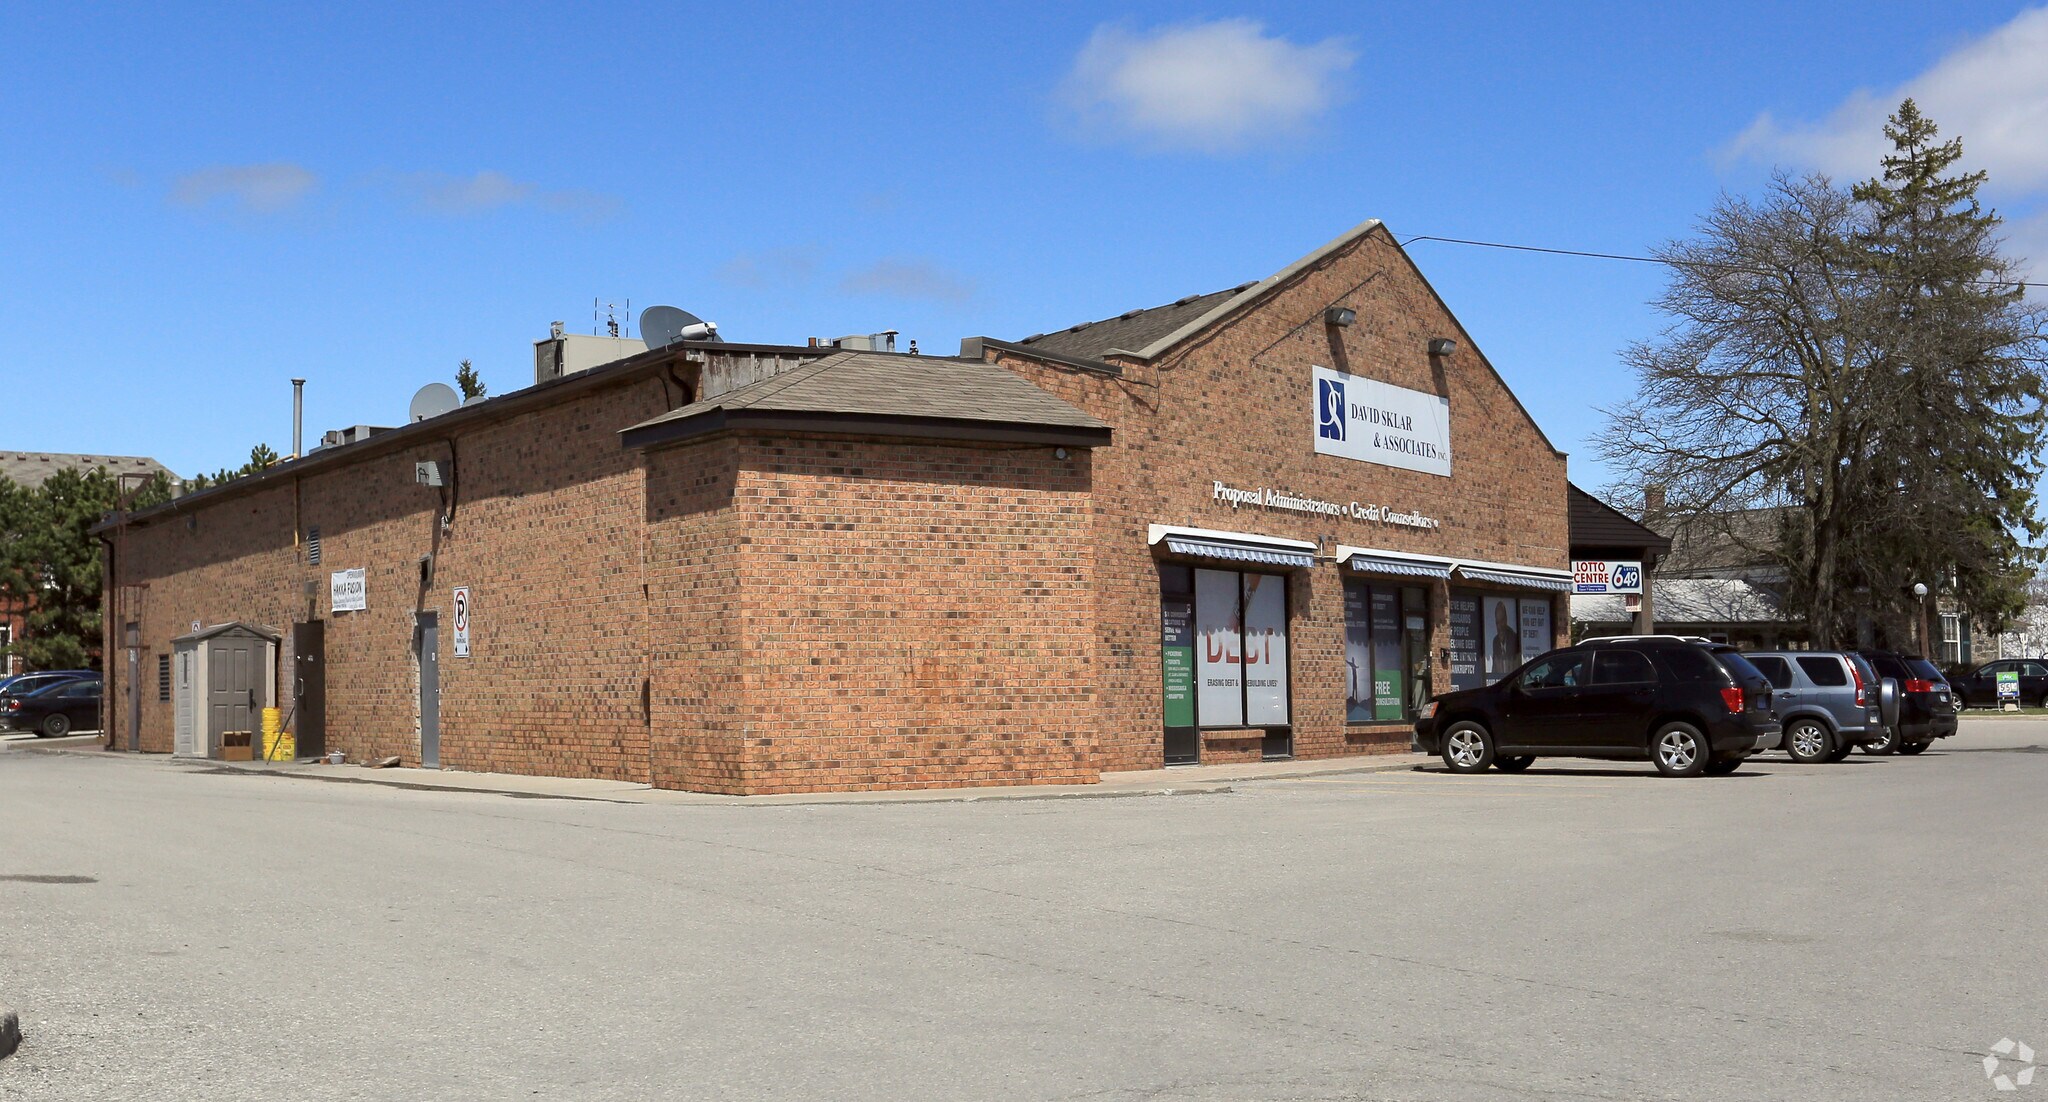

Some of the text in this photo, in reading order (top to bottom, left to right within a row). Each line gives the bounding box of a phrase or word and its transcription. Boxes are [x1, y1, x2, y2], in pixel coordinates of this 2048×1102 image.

[1351, 403, 1412, 431] DAVID SKLAR
[1374, 432, 1381, 448] &
[1383, 435, 1437, 459] ASSOCIATES
[1213, 480, 1432, 528] Proposal Administrators Credit Counsellors
[1576, 562, 1606, 572] LOTTO
[1573, 573, 1609, 583] CENTRE
[347, 582, 362, 595] FUSION
[1450, 613, 1471, 623] OUSANDS
[1451, 664, 1475, 674] ANKRUPTCY
[1207, 679, 1225, 687] ERASING
[1225, 679, 1235, 687] DEBT
[1235, 679, 1239, 687] &
[1247, 679, 1266, 687] EBUILDING
[1375, 681, 1391, 695] FREE
